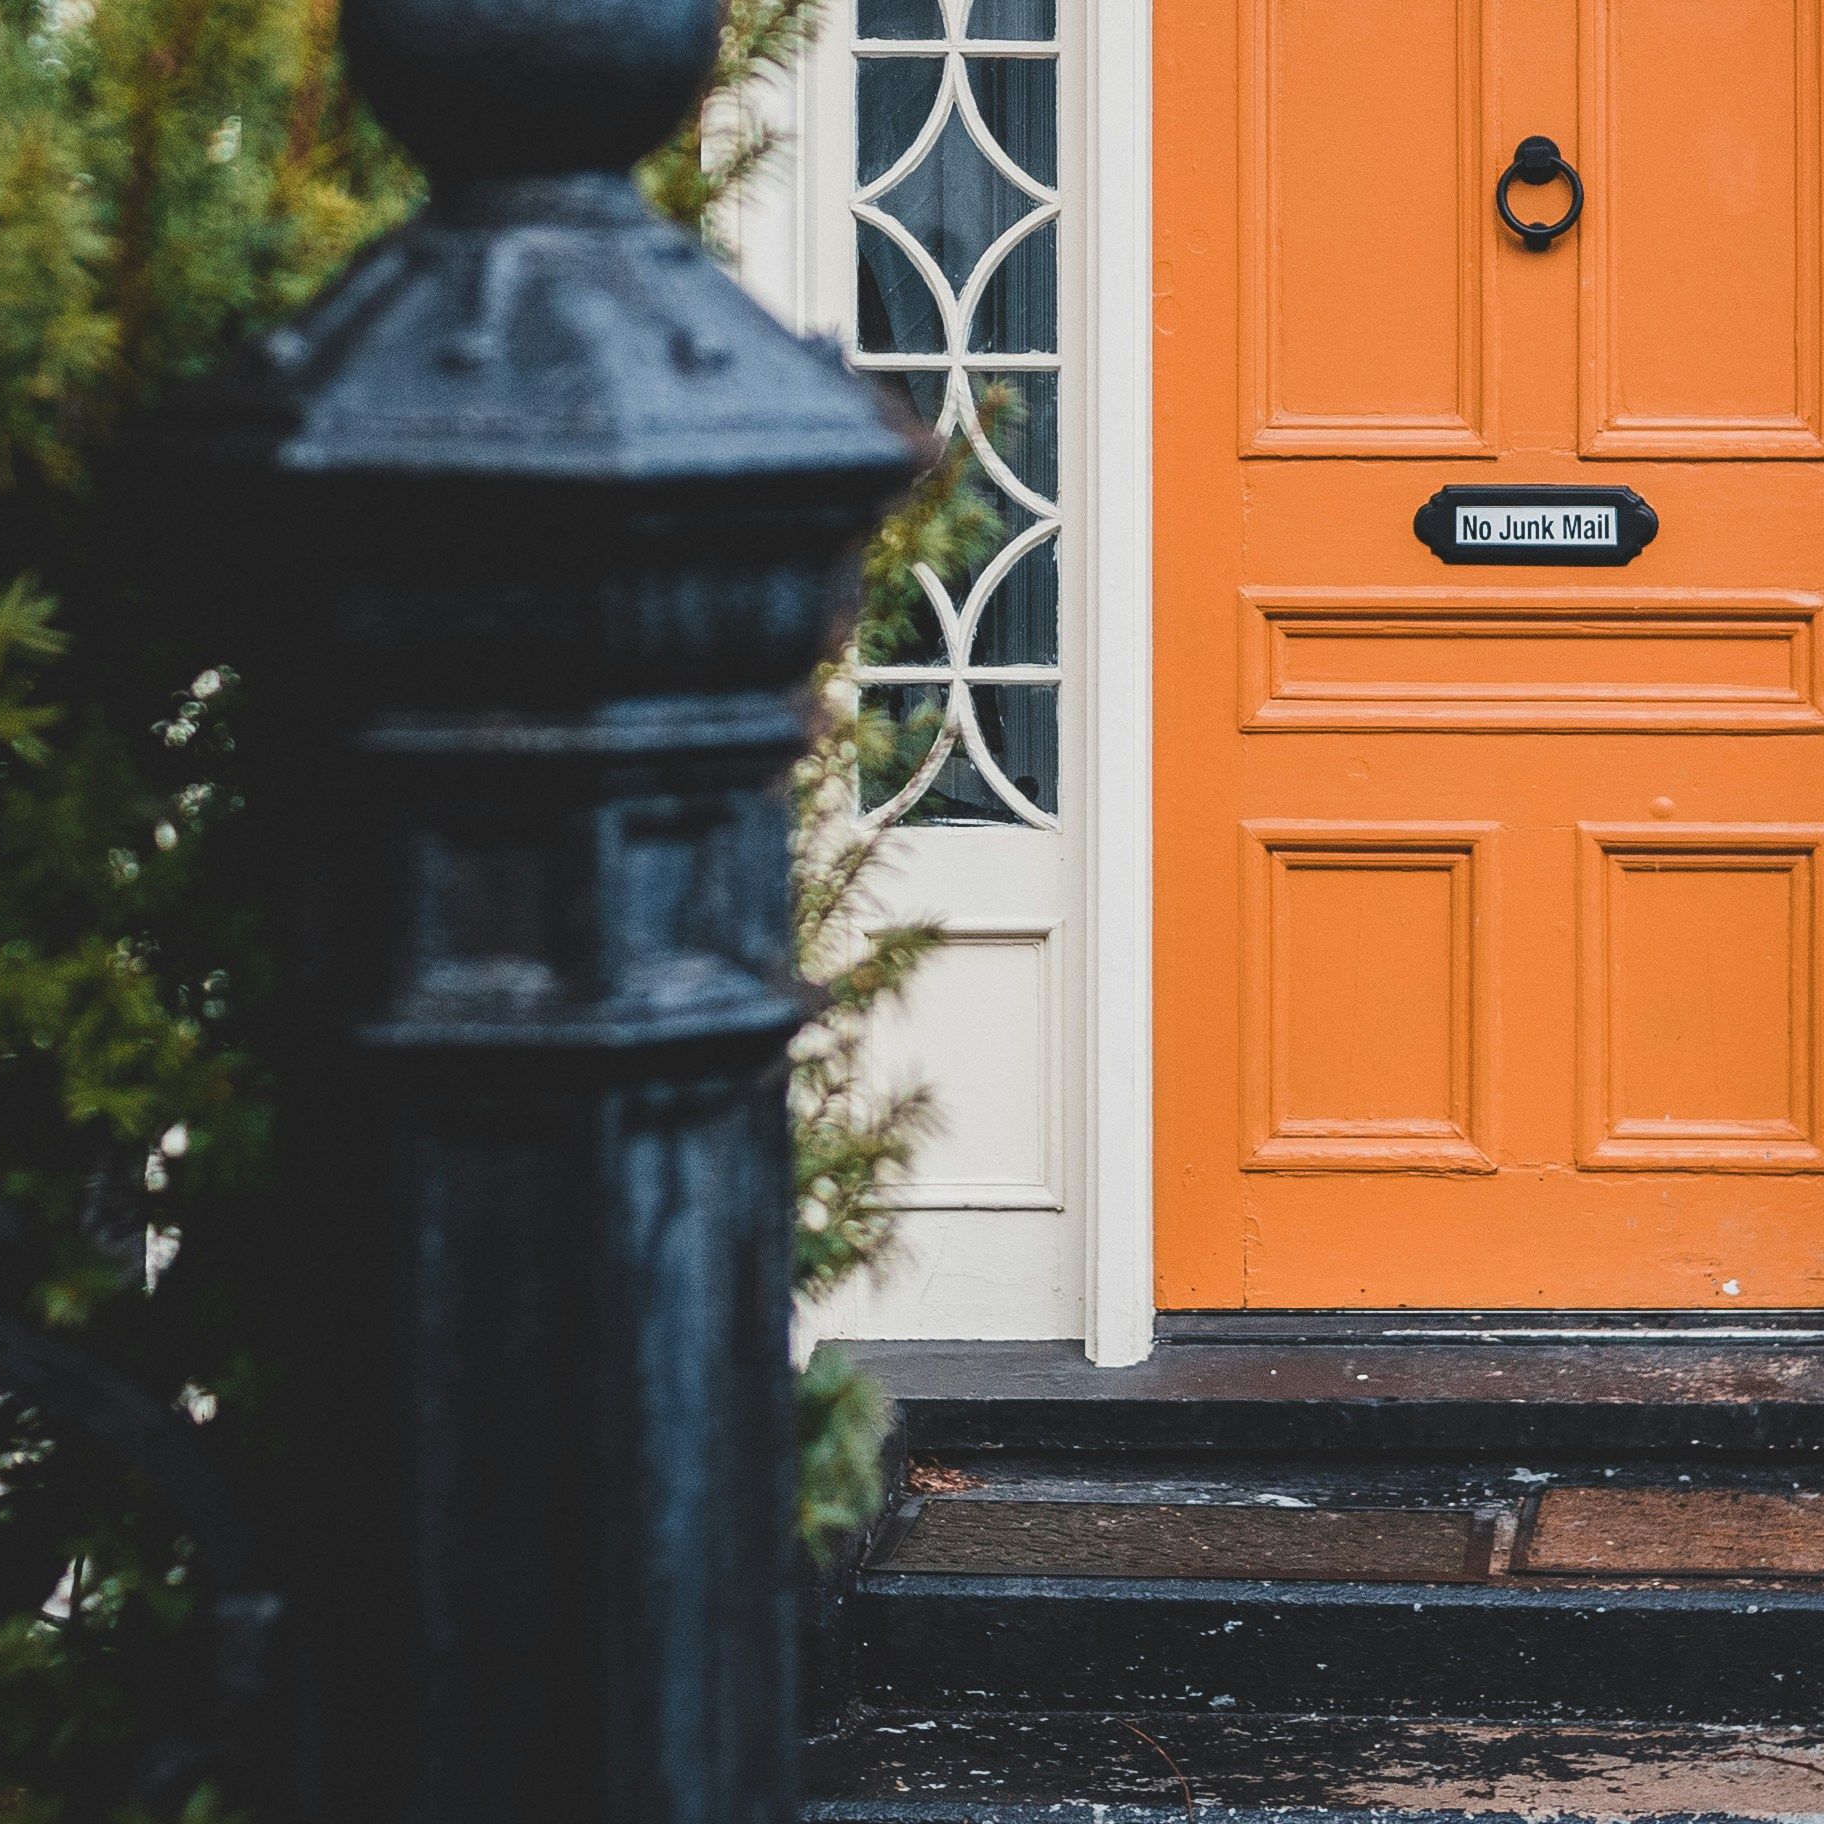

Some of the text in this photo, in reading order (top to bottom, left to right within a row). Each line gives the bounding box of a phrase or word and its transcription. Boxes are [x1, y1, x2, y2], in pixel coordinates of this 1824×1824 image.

[1462, 513, 1610, 541] No Junk Mail
